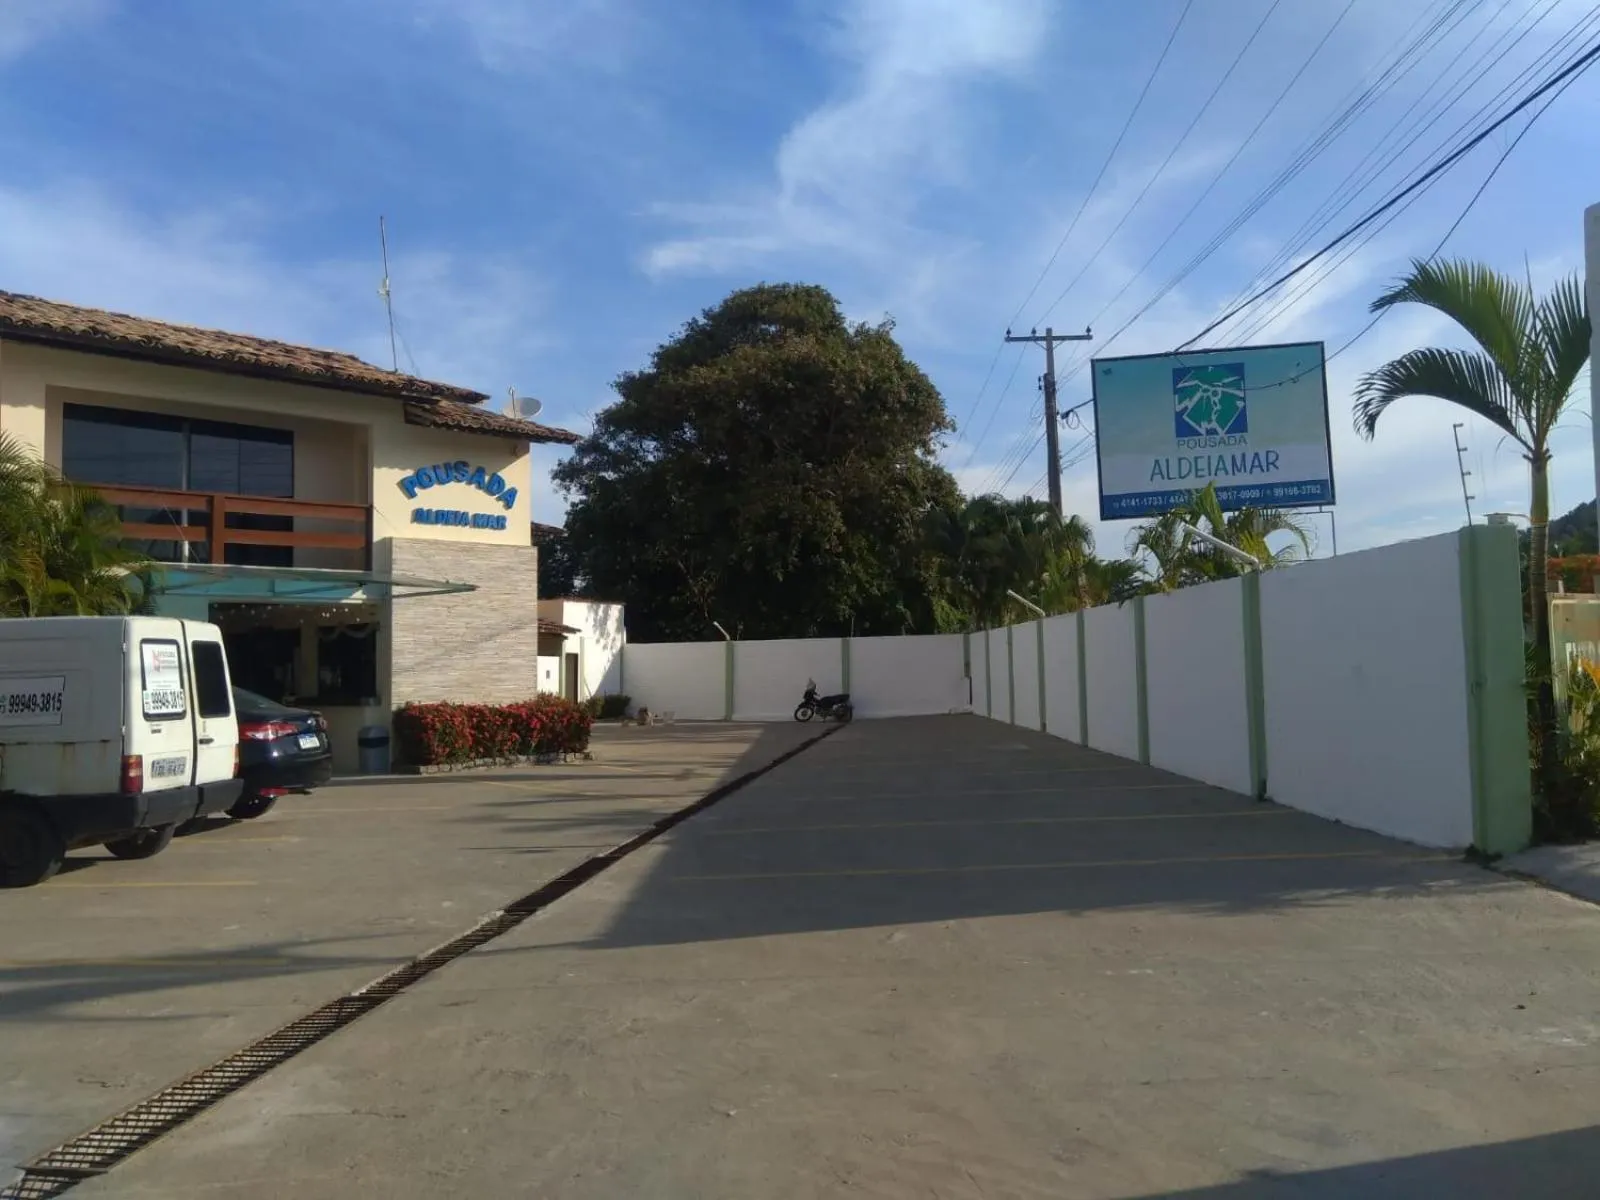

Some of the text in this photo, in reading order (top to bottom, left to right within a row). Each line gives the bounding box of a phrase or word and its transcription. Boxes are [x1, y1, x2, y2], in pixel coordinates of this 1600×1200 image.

[1177, 434, 1249, 450] POUSADA
[1149, 449, 1280, 482] ALDEIAMAR
[396, 460, 518, 511] POUSADA
[410, 507, 508, 531] ALDEIA MAR
[8, 692, 63, 714] 99949-3815
